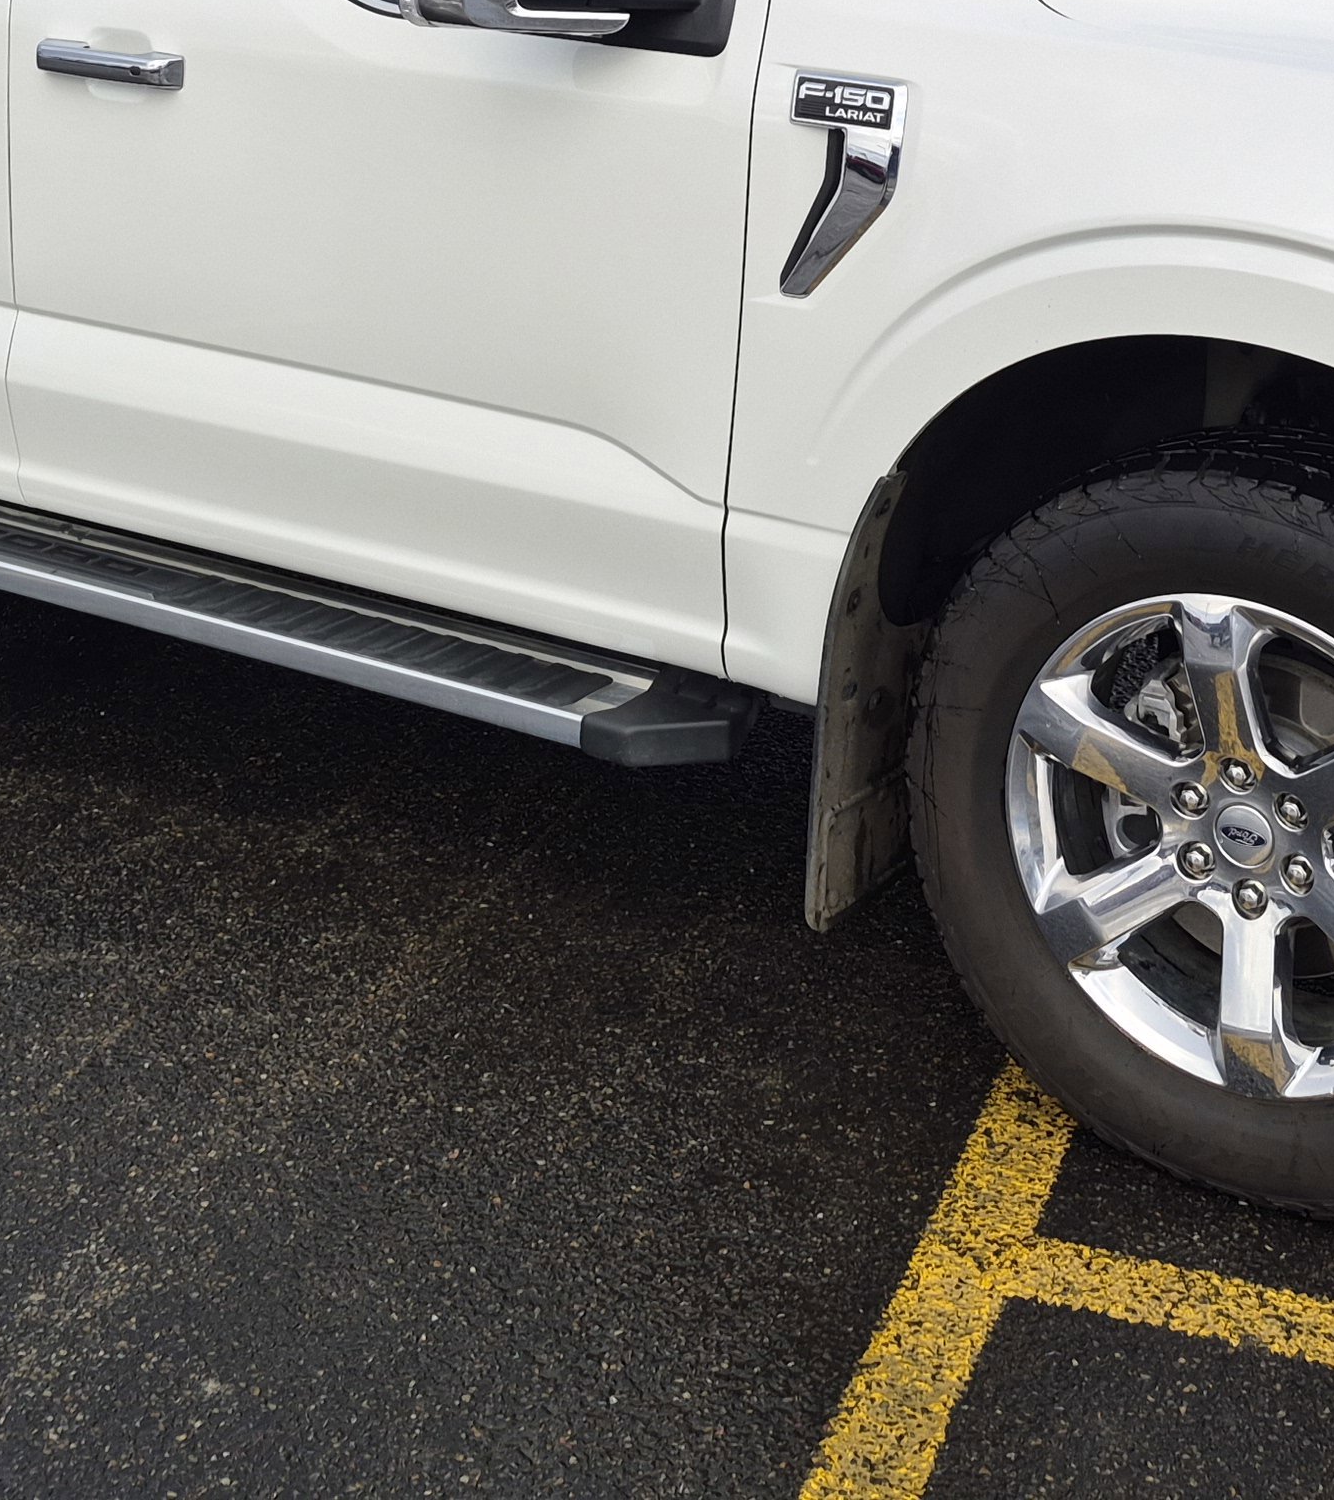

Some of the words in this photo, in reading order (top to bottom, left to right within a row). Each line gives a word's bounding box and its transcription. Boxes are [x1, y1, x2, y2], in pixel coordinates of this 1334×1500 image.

[798, 81, 892, 111] F-150
[825, 106, 885, 123] LARIAT
[1226, 827, 1259, 846] Ford
